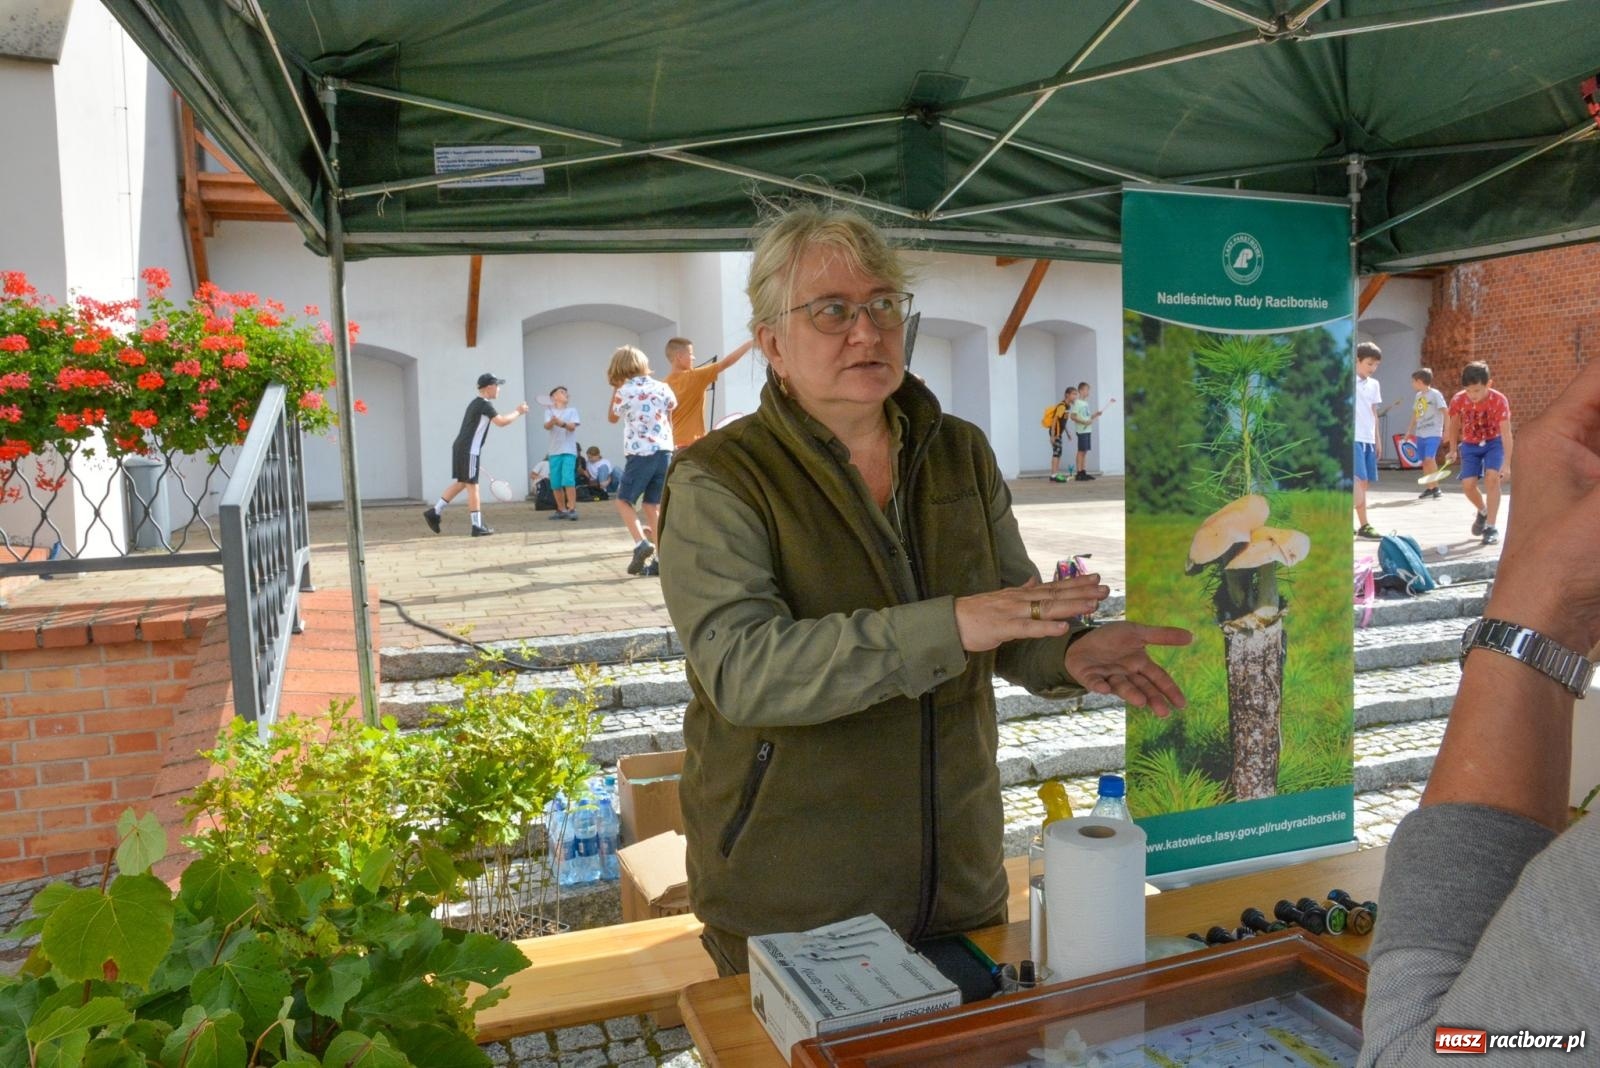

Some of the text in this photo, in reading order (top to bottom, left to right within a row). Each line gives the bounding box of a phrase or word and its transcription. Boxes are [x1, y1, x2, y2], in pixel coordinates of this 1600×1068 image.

[1157, 291, 1329, 310] Nadleśnictwo Rudy Raciborskie
[1146, 810, 1347, 854] ww.katowice.lasy.gov.pl/rudyraciborskie
[899, 1000, 951, 1018] HIRSCHMANN
